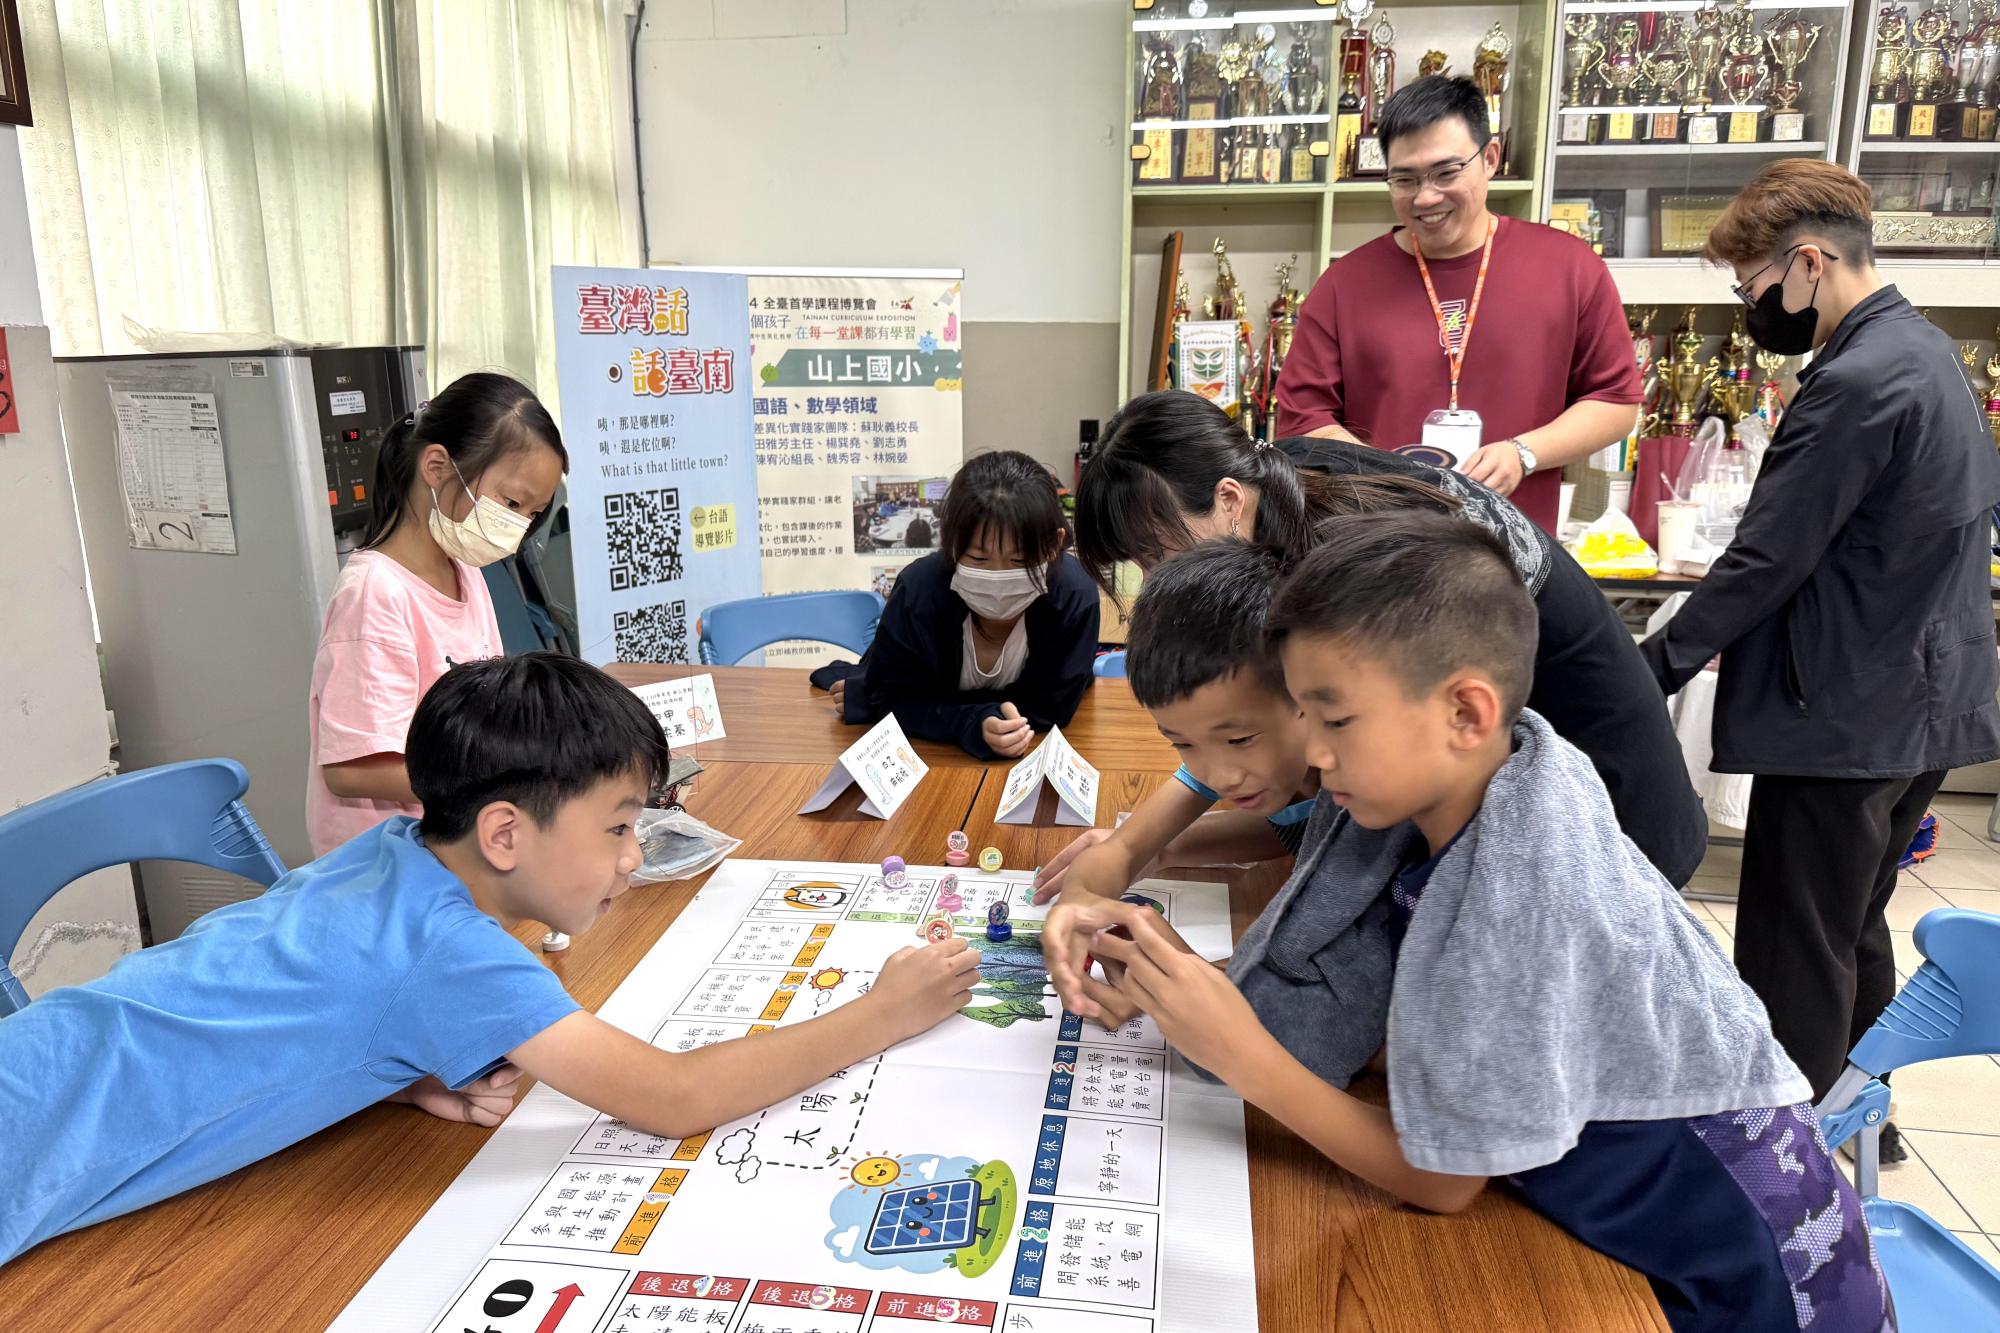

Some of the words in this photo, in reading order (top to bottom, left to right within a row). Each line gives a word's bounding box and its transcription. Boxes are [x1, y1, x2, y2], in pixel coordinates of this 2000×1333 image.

[577, 284, 689, 335] 臺灣話
[763, 297, 877, 310] 全臺首學課程博覽會
[795, 325, 916, 341] 在每一堂課都有學習
[808, 354, 922, 383] 山上國小
[753, 397, 878, 415] 國語、數學領域
[601, 464, 631, 479] What
[633, 463, 643, 475] is
[646, 459, 668, 474] that
[671, 456, 697, 471] little
[699, 454, 728, 469] town?
[1035, 1124, 1064, 1190] 原地休息
[1098, 1128, 1123, 1193] 寧靜的一天
[530, 1171, 590, 1236] 參與國家
[558, 1171, 618, 1239] 再生能源
[1057, 1217, 1086, 1286] 開發儲能
[618, 1303, 730, 1326] 太陽能板
